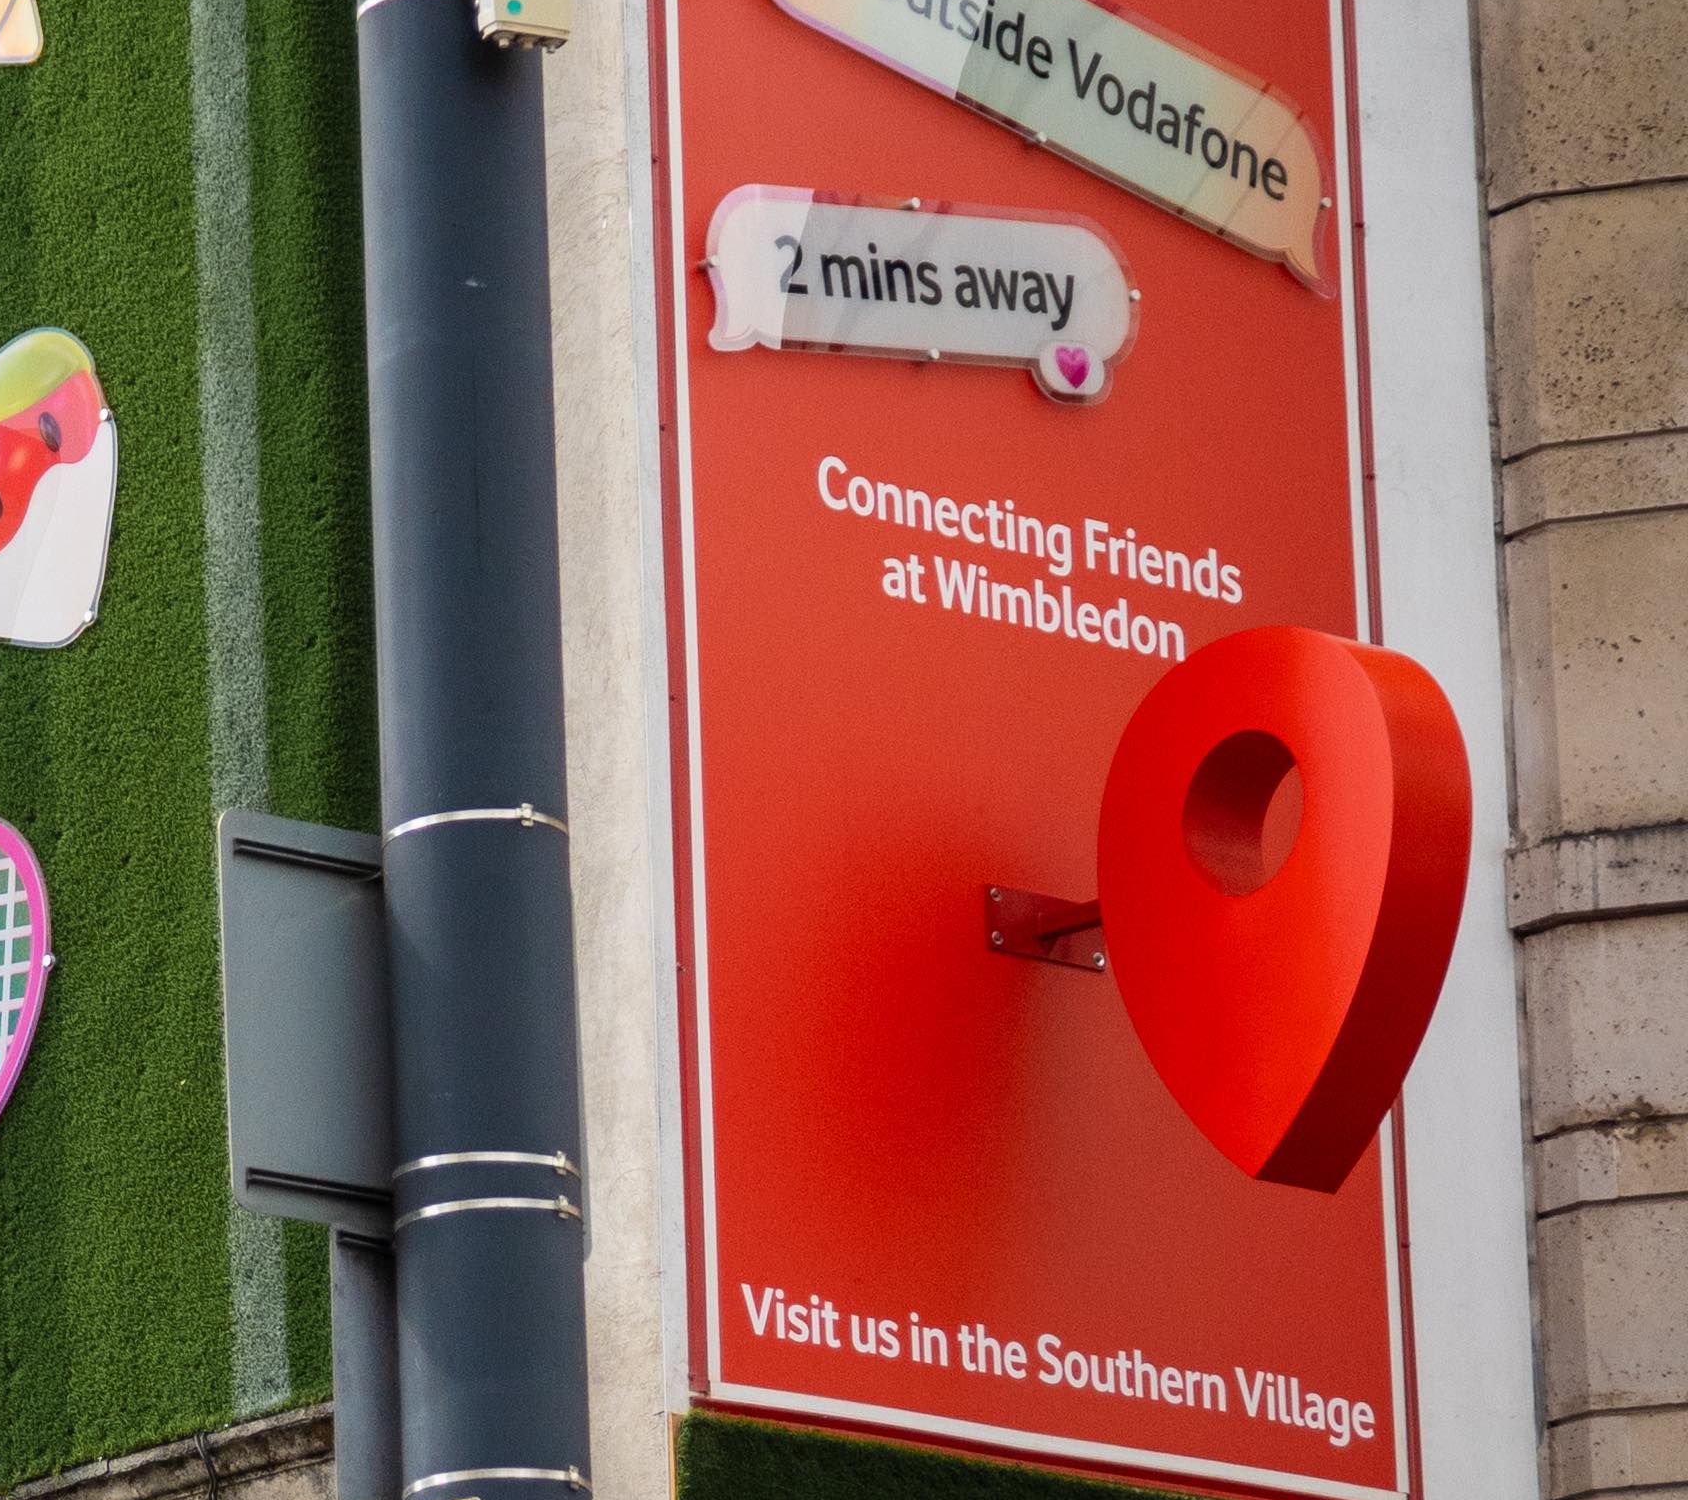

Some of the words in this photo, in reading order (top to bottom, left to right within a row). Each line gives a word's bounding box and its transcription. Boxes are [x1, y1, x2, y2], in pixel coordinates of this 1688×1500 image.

[1068, 36, 1289, 203] Vodafone
[773, 234, 805, 295] 2
[821, 243, 942, 306] mins
[954, 263, 1075, 331] away
[817, 456, 1073, 577] Connecting
[1083, 518, 1244, 604] Friends
[882, 555, 927, 604] at
[933, 556, 1186, 662] Wimbledon
[741, 1284, 841, 1349] Visit
[851, 1314, 901, 1359] us
[909, 1313, 950, 1366] in
[958, 1324, 1028, 1379] the
[1037, 1334, 1228, 1413] Southern
[1234, 1367, 1376, 1447] Village
